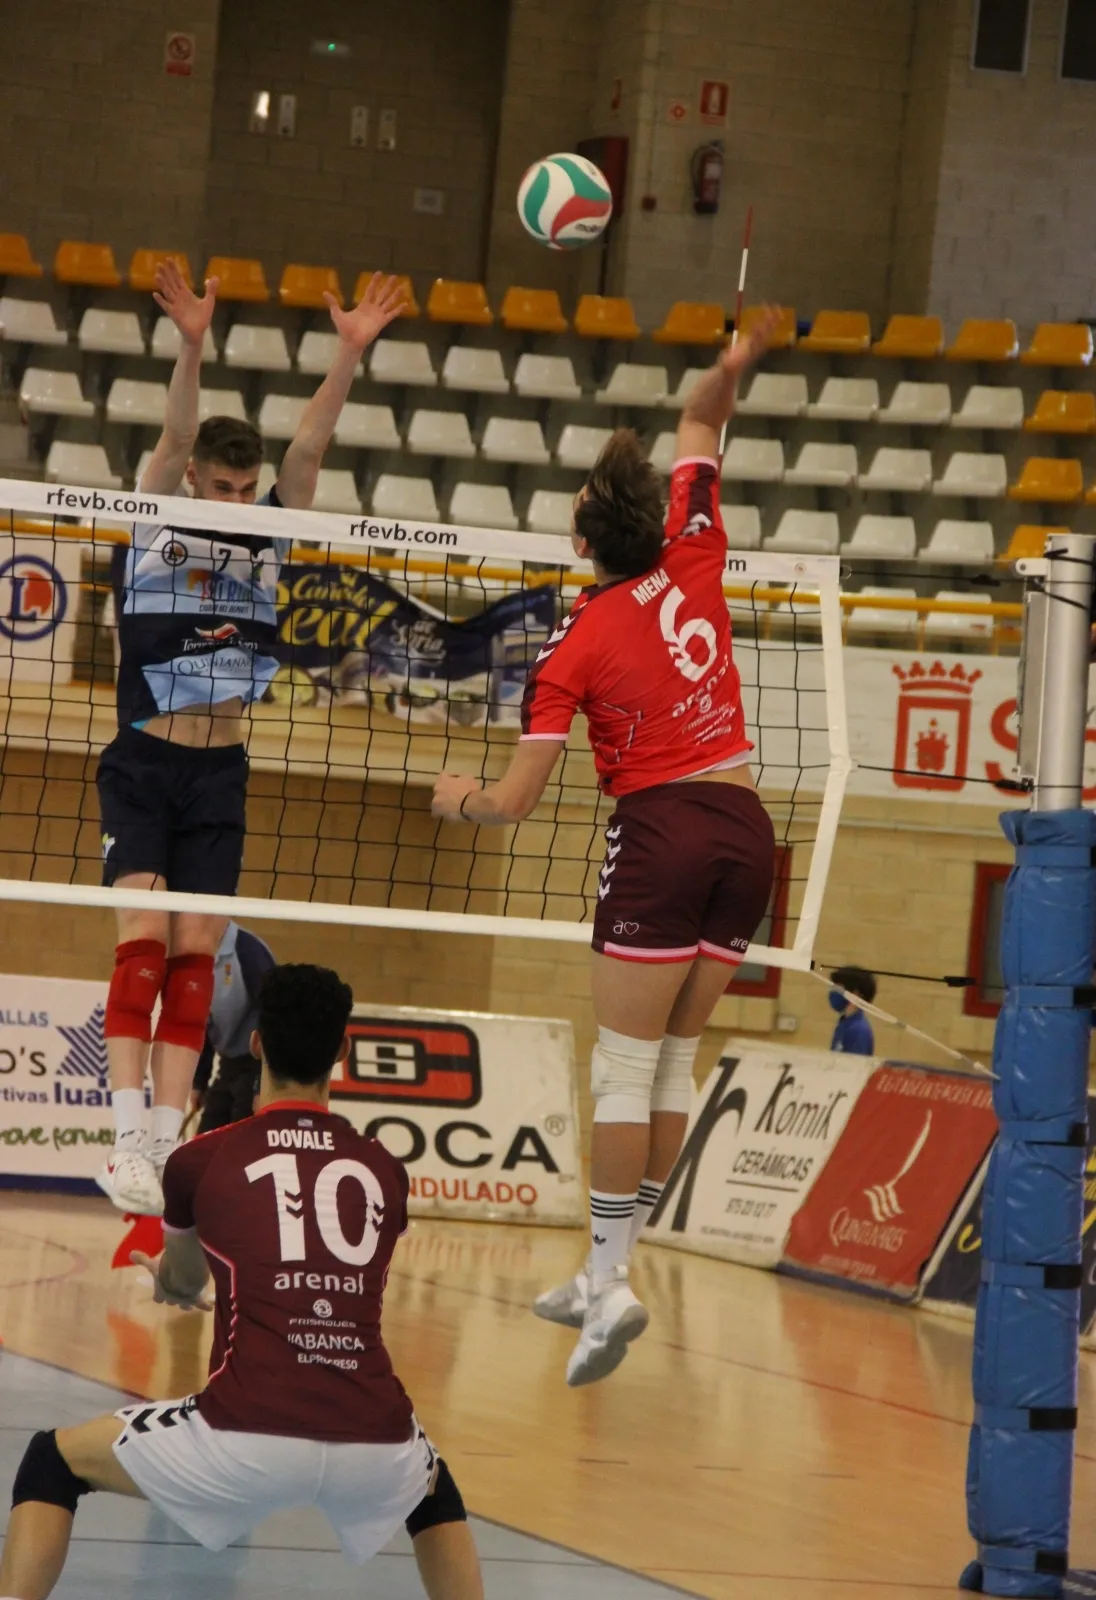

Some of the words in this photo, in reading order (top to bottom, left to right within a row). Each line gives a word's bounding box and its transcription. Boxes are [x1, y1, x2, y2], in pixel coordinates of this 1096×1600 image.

[46, 488, 159, 516] rfevb.com
[349, 519, 458, 546] rfevb.com
[218, 548, 232, 573] 7
[631, 568, 671, 606] MENA
[659, 585, 718, 682] 6
[267, 1129, 335, 1150] DOVALE
[244, 1153, 385, 1266] 10
[274, 1271, 364, 1295] arenal
